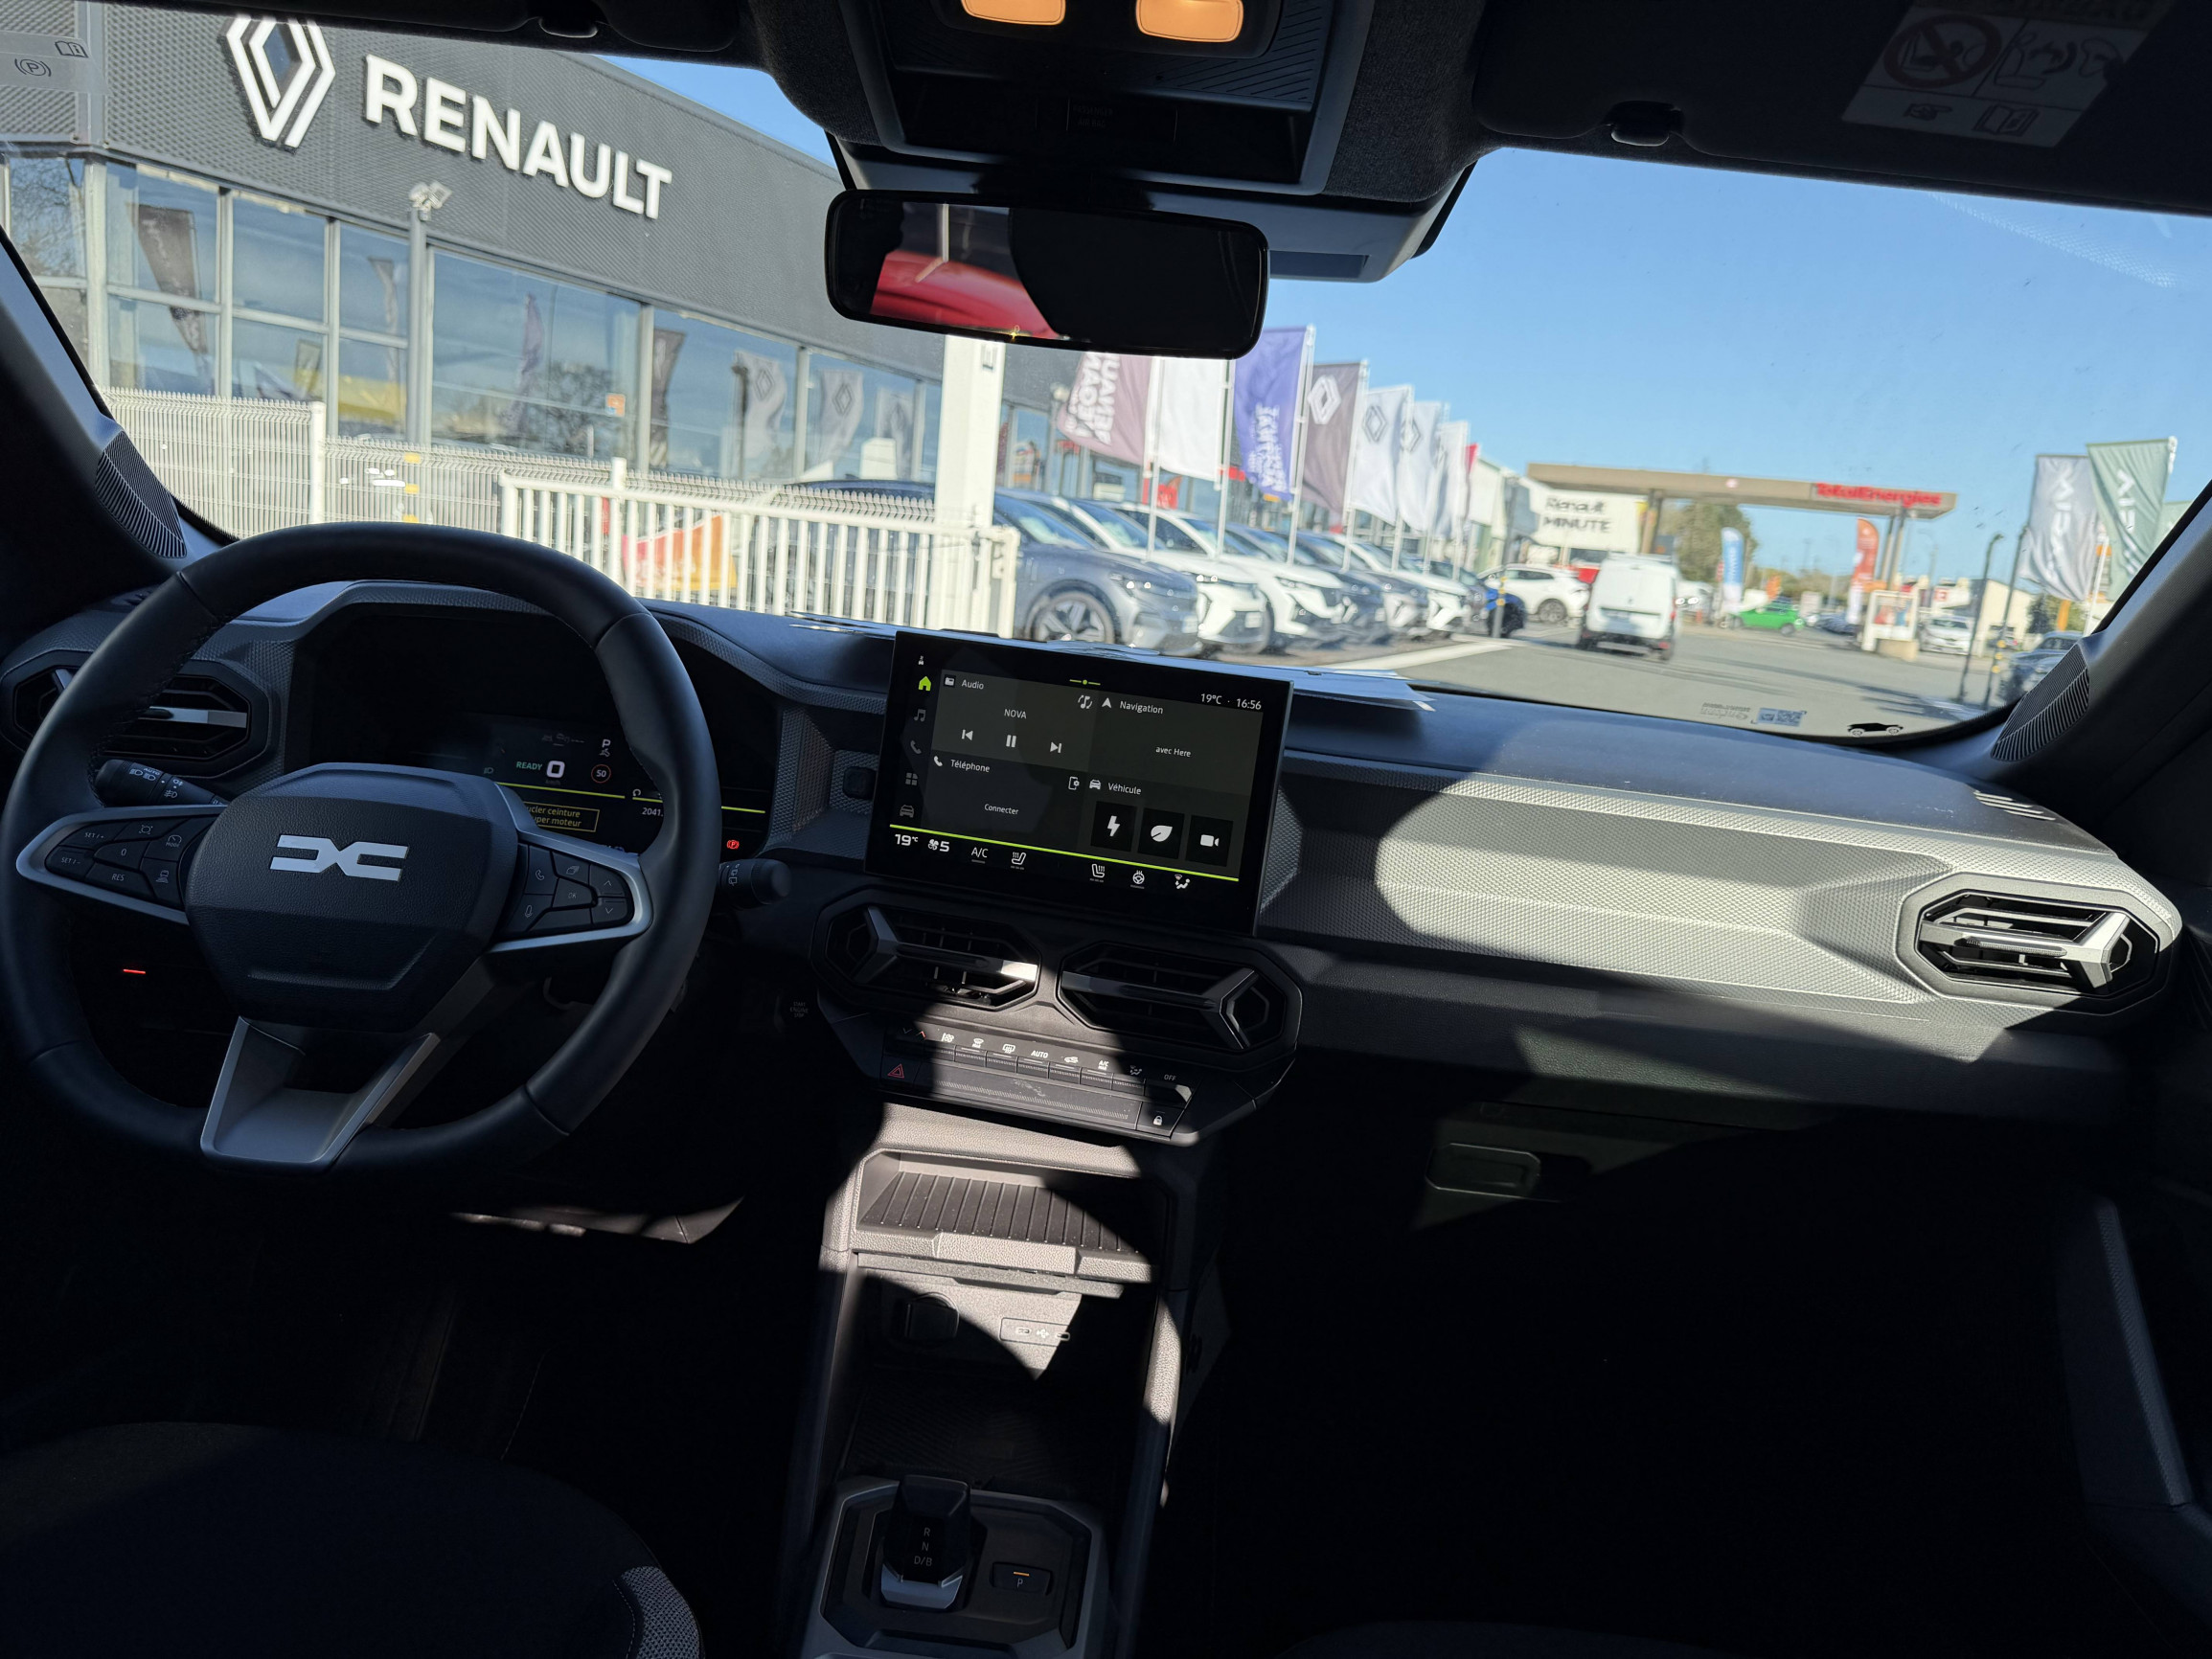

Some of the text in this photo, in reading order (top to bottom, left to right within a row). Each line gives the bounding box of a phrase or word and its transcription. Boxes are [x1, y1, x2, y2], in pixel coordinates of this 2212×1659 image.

[364, 54, 673, 220] RENAULT
[1542, 516, 1611, 534] MINUTE
[961, 677, 985, 691] Audio
[1119, 699, 1164, 715] Navigation
[1200, 693, 1263, 711] 19°C 16:56
[1003, 708, 1028, 719] NOVA
[602, 739, 611, 748] P
[1155, 745, 1192, 758] avec Here
[143, 767, 161, 776] AUTO
[515, 761, 543, 771] READY
[950, 759, 991, 774] Téléphone
[596, 769, 607, 778] 50
[1107, 782, 1142, 796] Véhicule
[527, 806, 581, 818] ucler ceinture
[984, 803, 1019, 815] Connecter
[551, 817, 582, 828] moteur
[938, 840, 950, 853] 5
[970, 846, 989, 859] A/C
[111, 873, 125, 882] RES
[1031, 1049, 1049, 1059] AUTO
[1163, 1074, 1177, 1082] OFF
[924, 1527, 931, 1537] R
[922, 1541, 929, 1552] N
[914, 1556, 933, 1567] D/B
[1016, 1579, 1024, 1588] P
